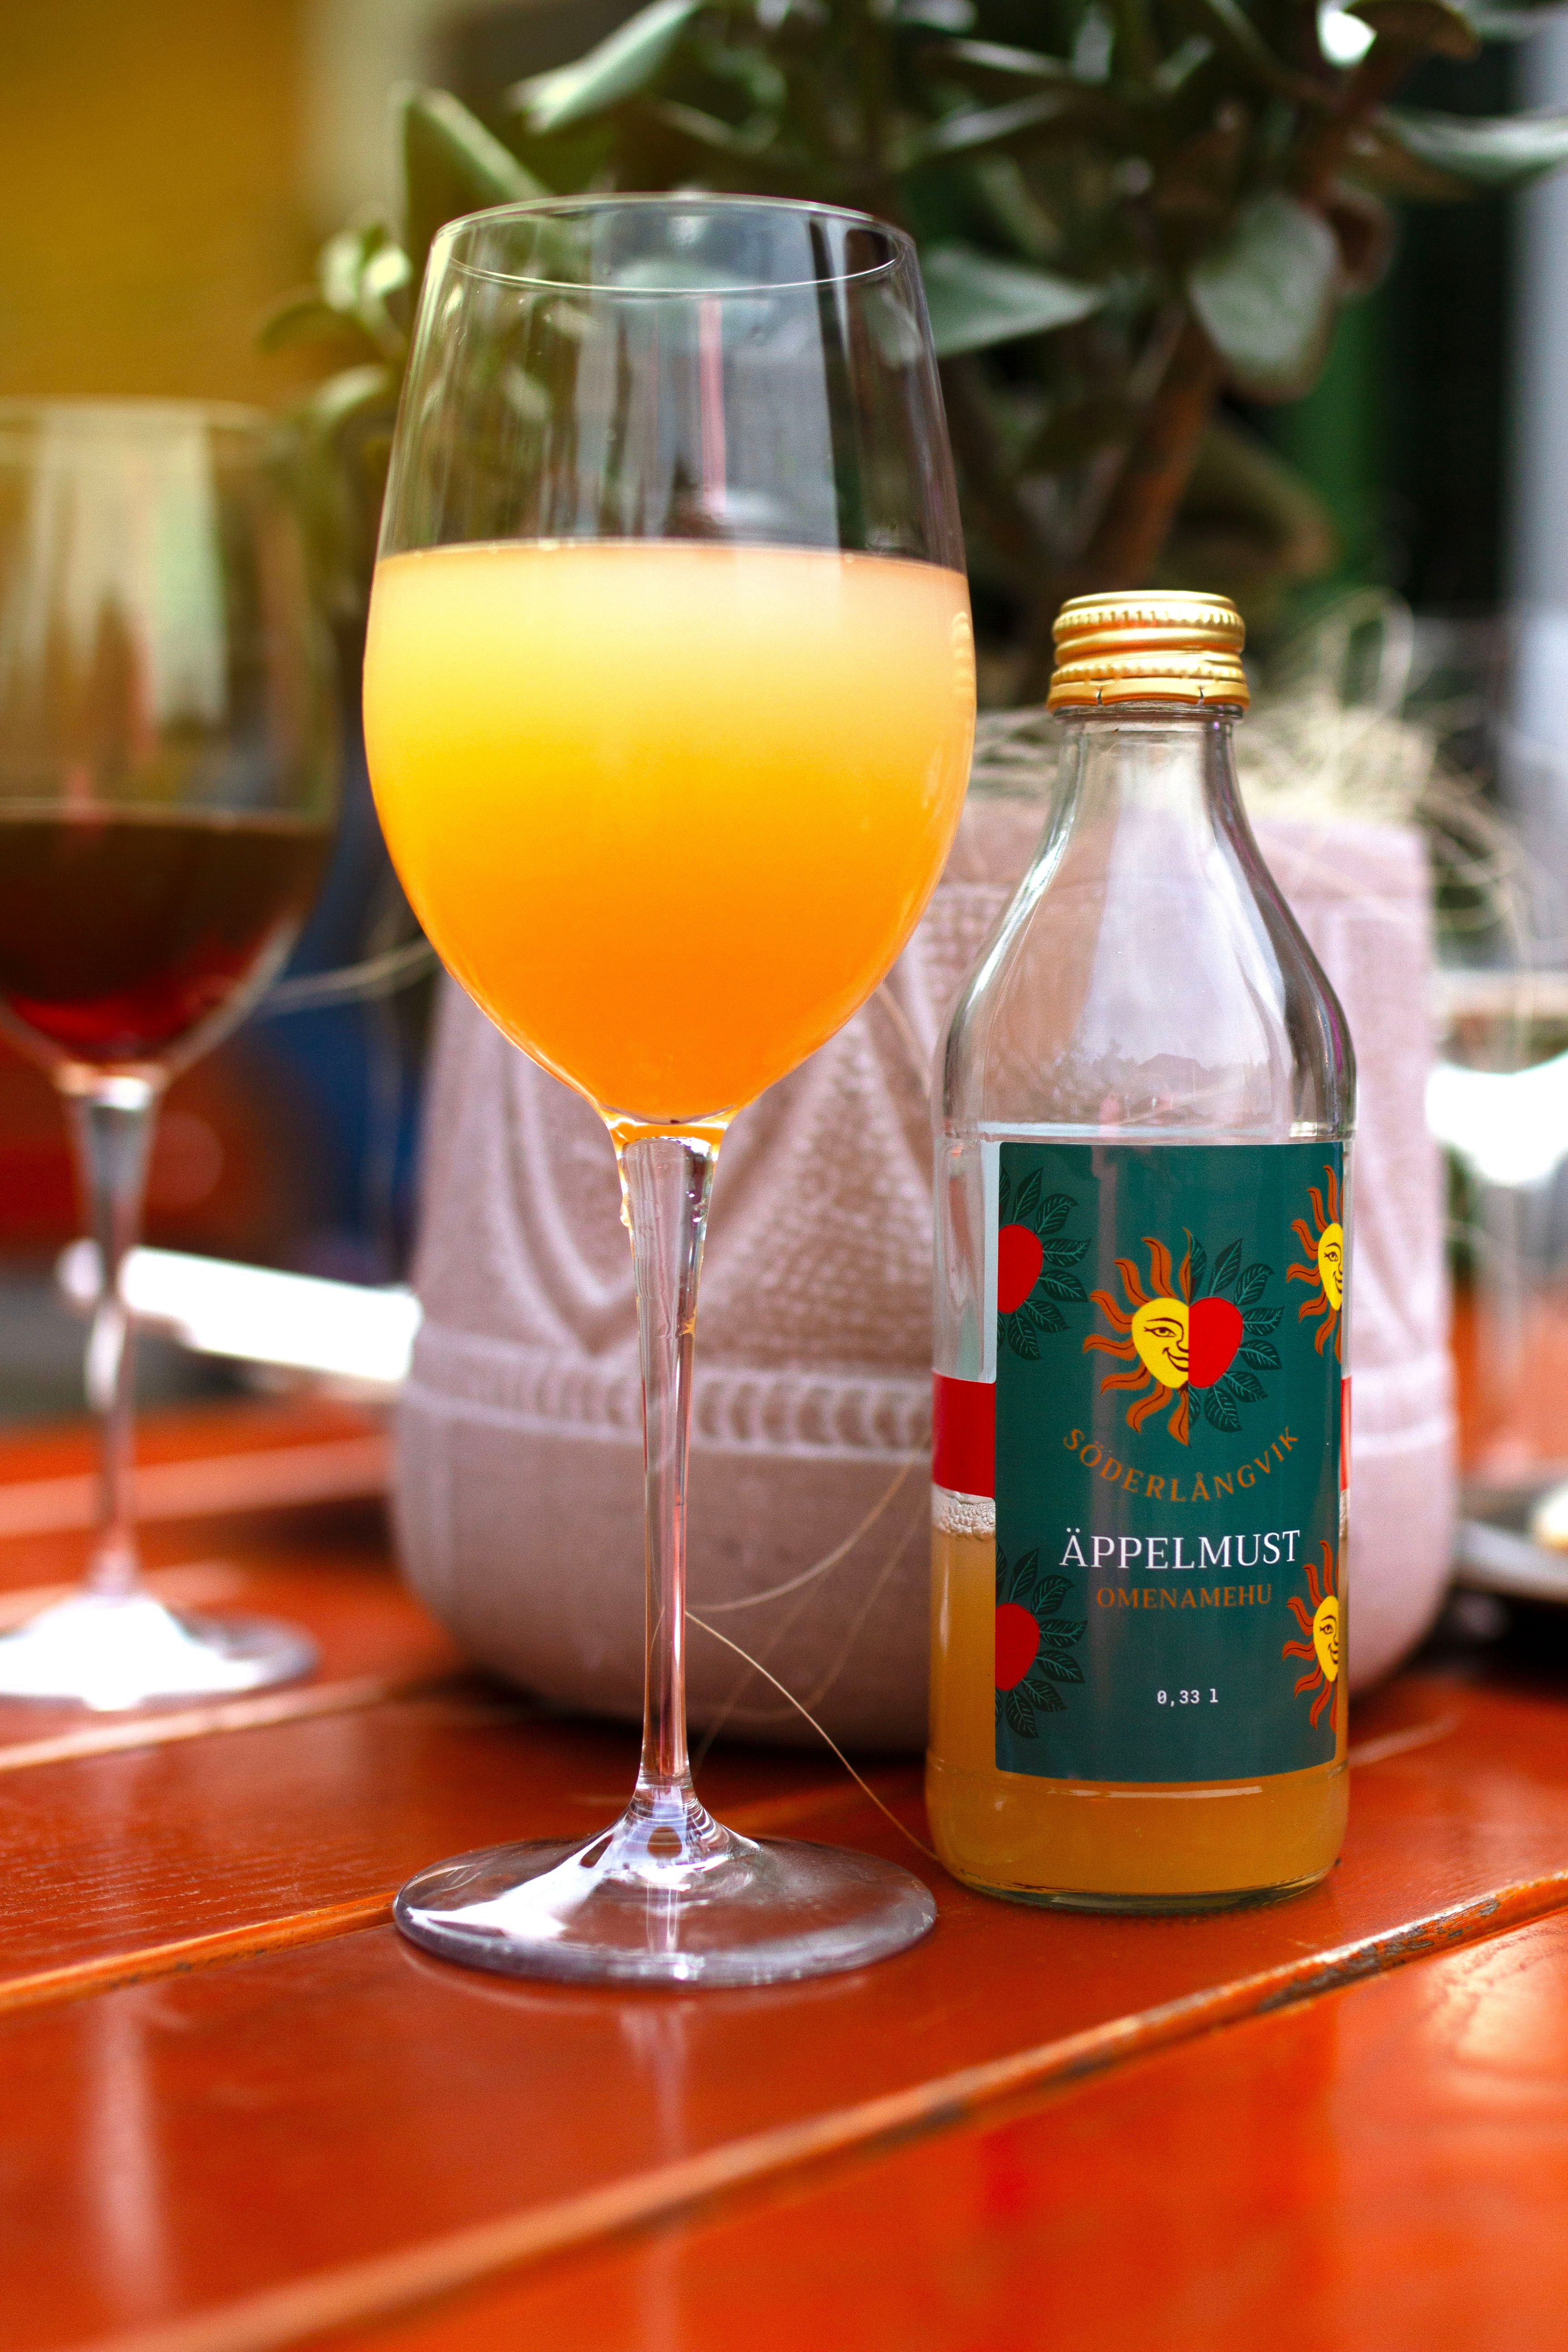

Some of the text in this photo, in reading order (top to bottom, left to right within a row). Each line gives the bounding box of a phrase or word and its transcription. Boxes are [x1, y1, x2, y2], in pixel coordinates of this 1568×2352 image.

[1063, 1426, 1298, 1502] SÖDERLÅNGVIK
[1059, 1527, 1300, 1569] ÄPPELMUST
[1097, 1584, 1271, 1609] OMENAMEHU
[1157, 1690, 1200, 1707] 0,33
